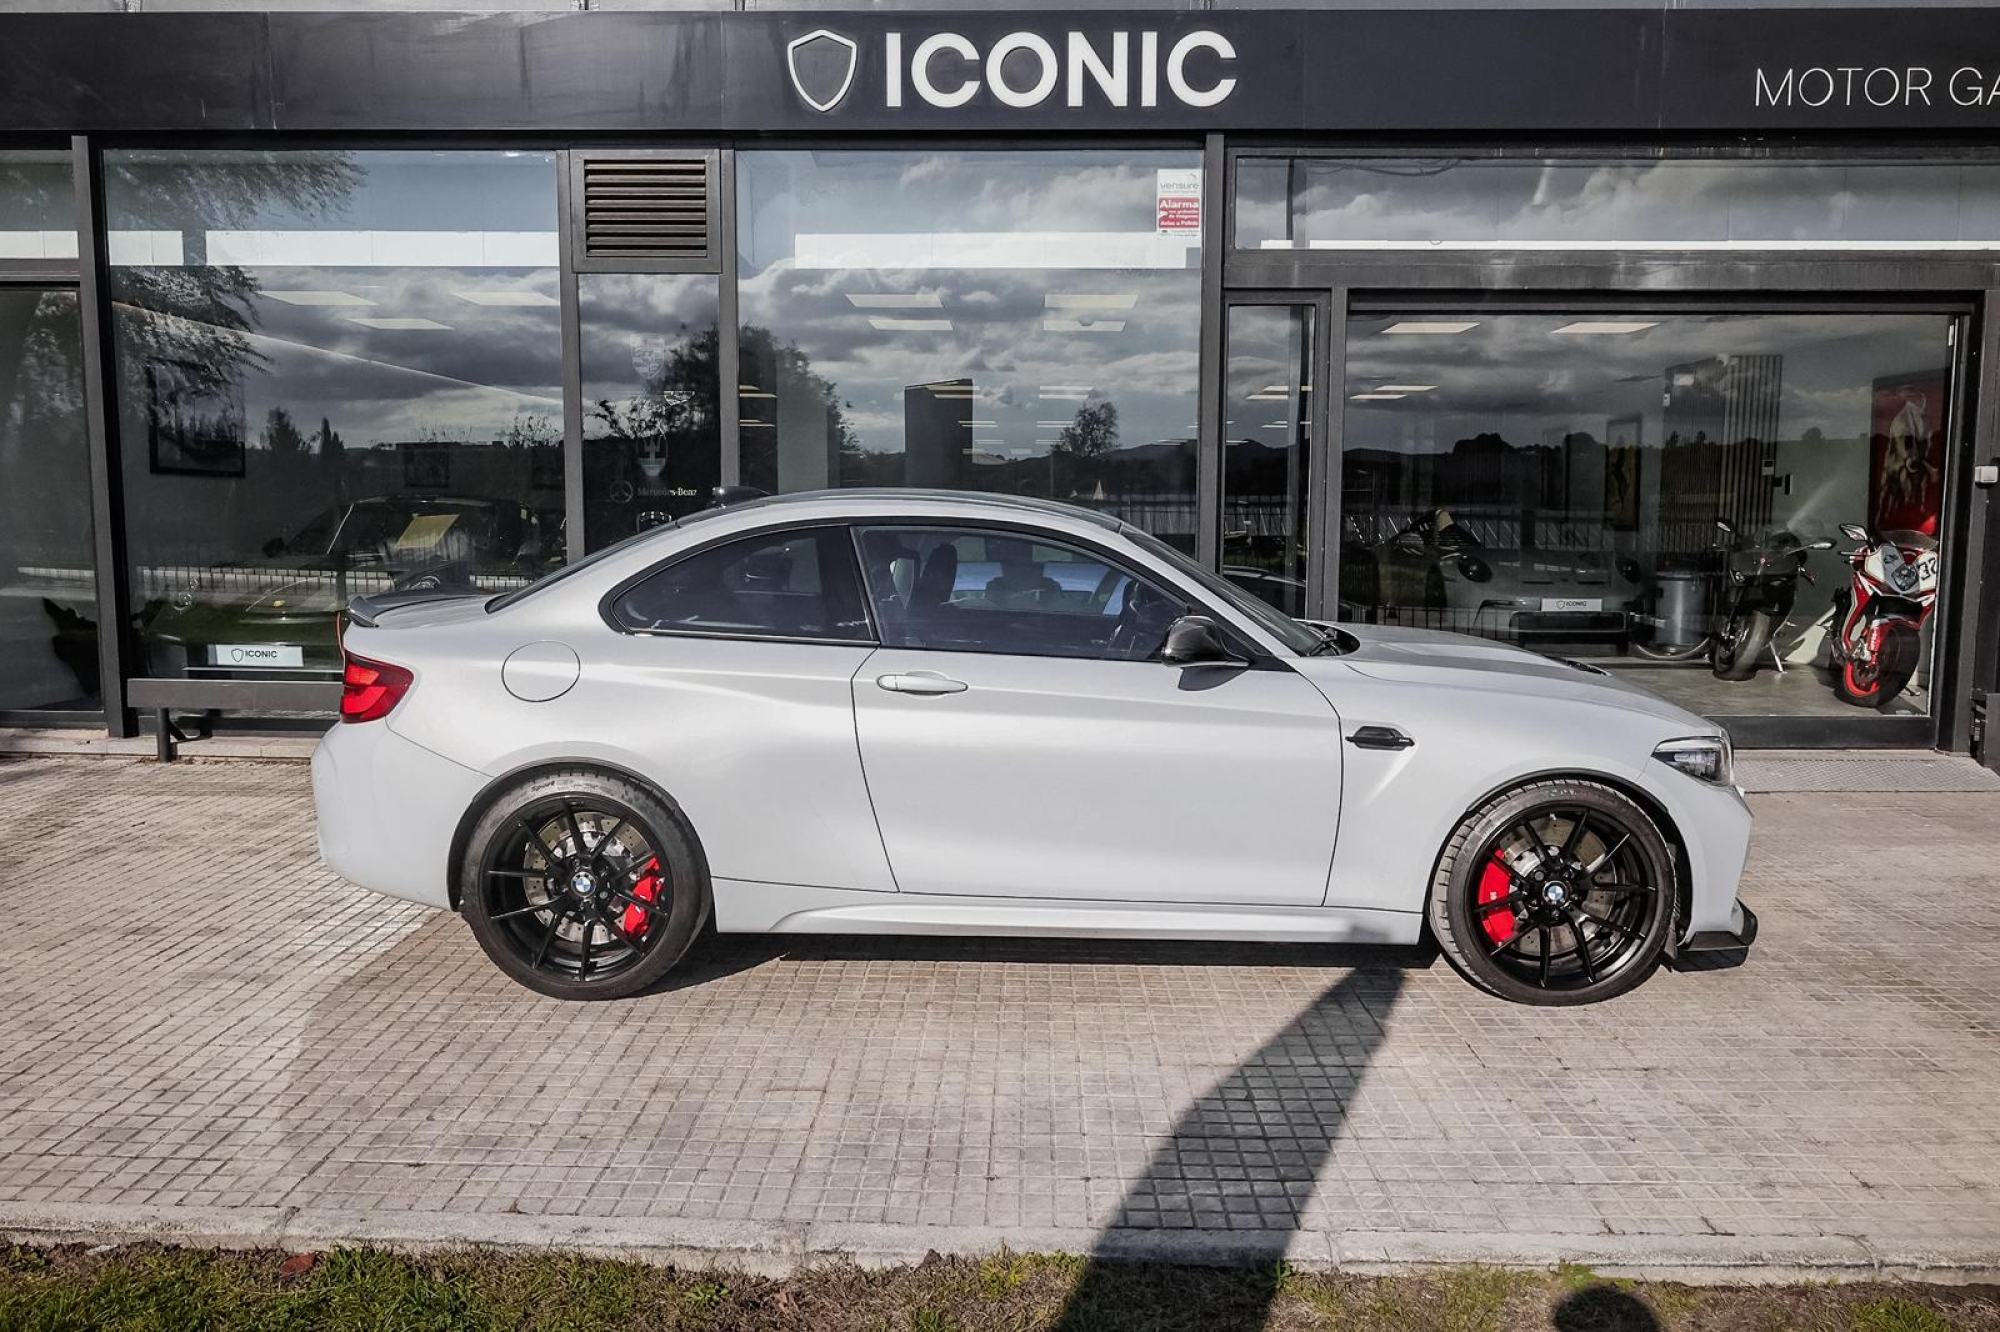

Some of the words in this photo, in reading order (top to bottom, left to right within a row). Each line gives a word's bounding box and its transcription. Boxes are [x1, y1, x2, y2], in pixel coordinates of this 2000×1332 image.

[886, 31, 1237, 107] ICONIC
[1755, 67, 1932, 106] MOTOR
[1159, 199, 1199, 209] Alarma
[245, 650, 278, 658] ICONIC
